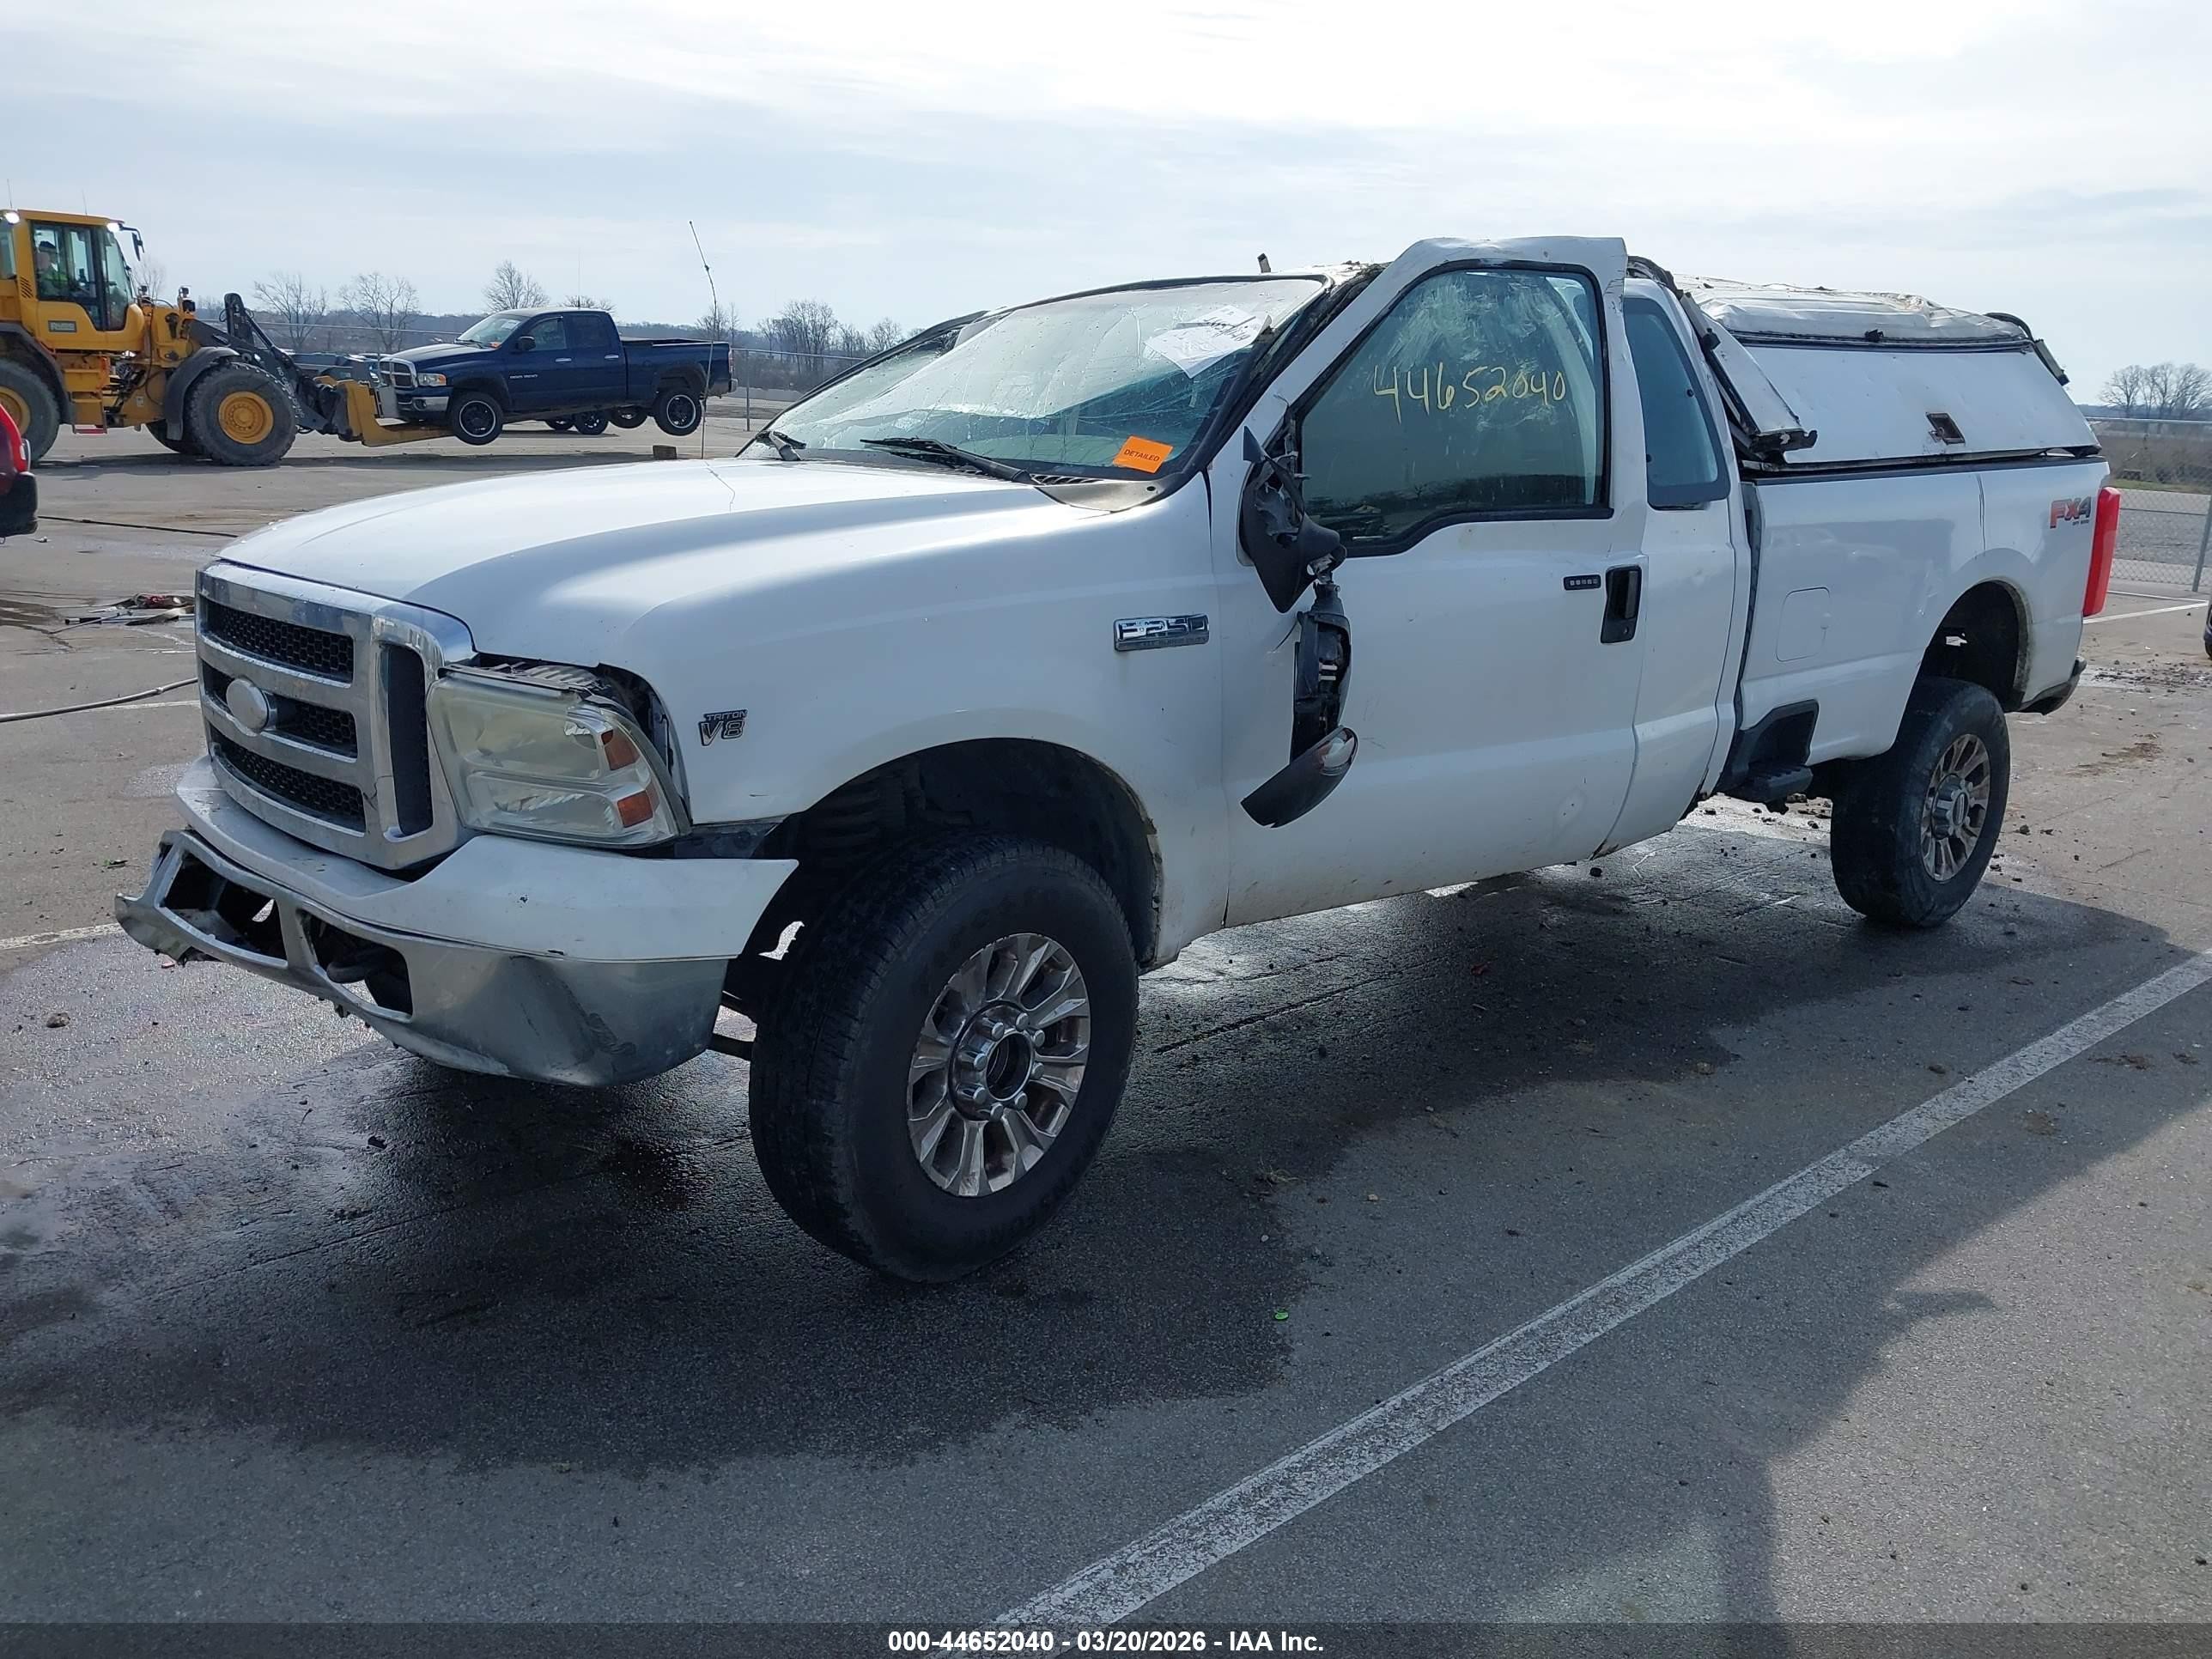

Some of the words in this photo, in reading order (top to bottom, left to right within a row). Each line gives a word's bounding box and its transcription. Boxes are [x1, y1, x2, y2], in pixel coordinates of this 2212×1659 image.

[1372, 361, 1566, 426] 44652040
[1123, 448, 1161, 462] DETAILED
[2049, 495, 2092, 529] FX4
[706, 710, 748, 721] TRITON
[699, 720, 745, 746] V8
